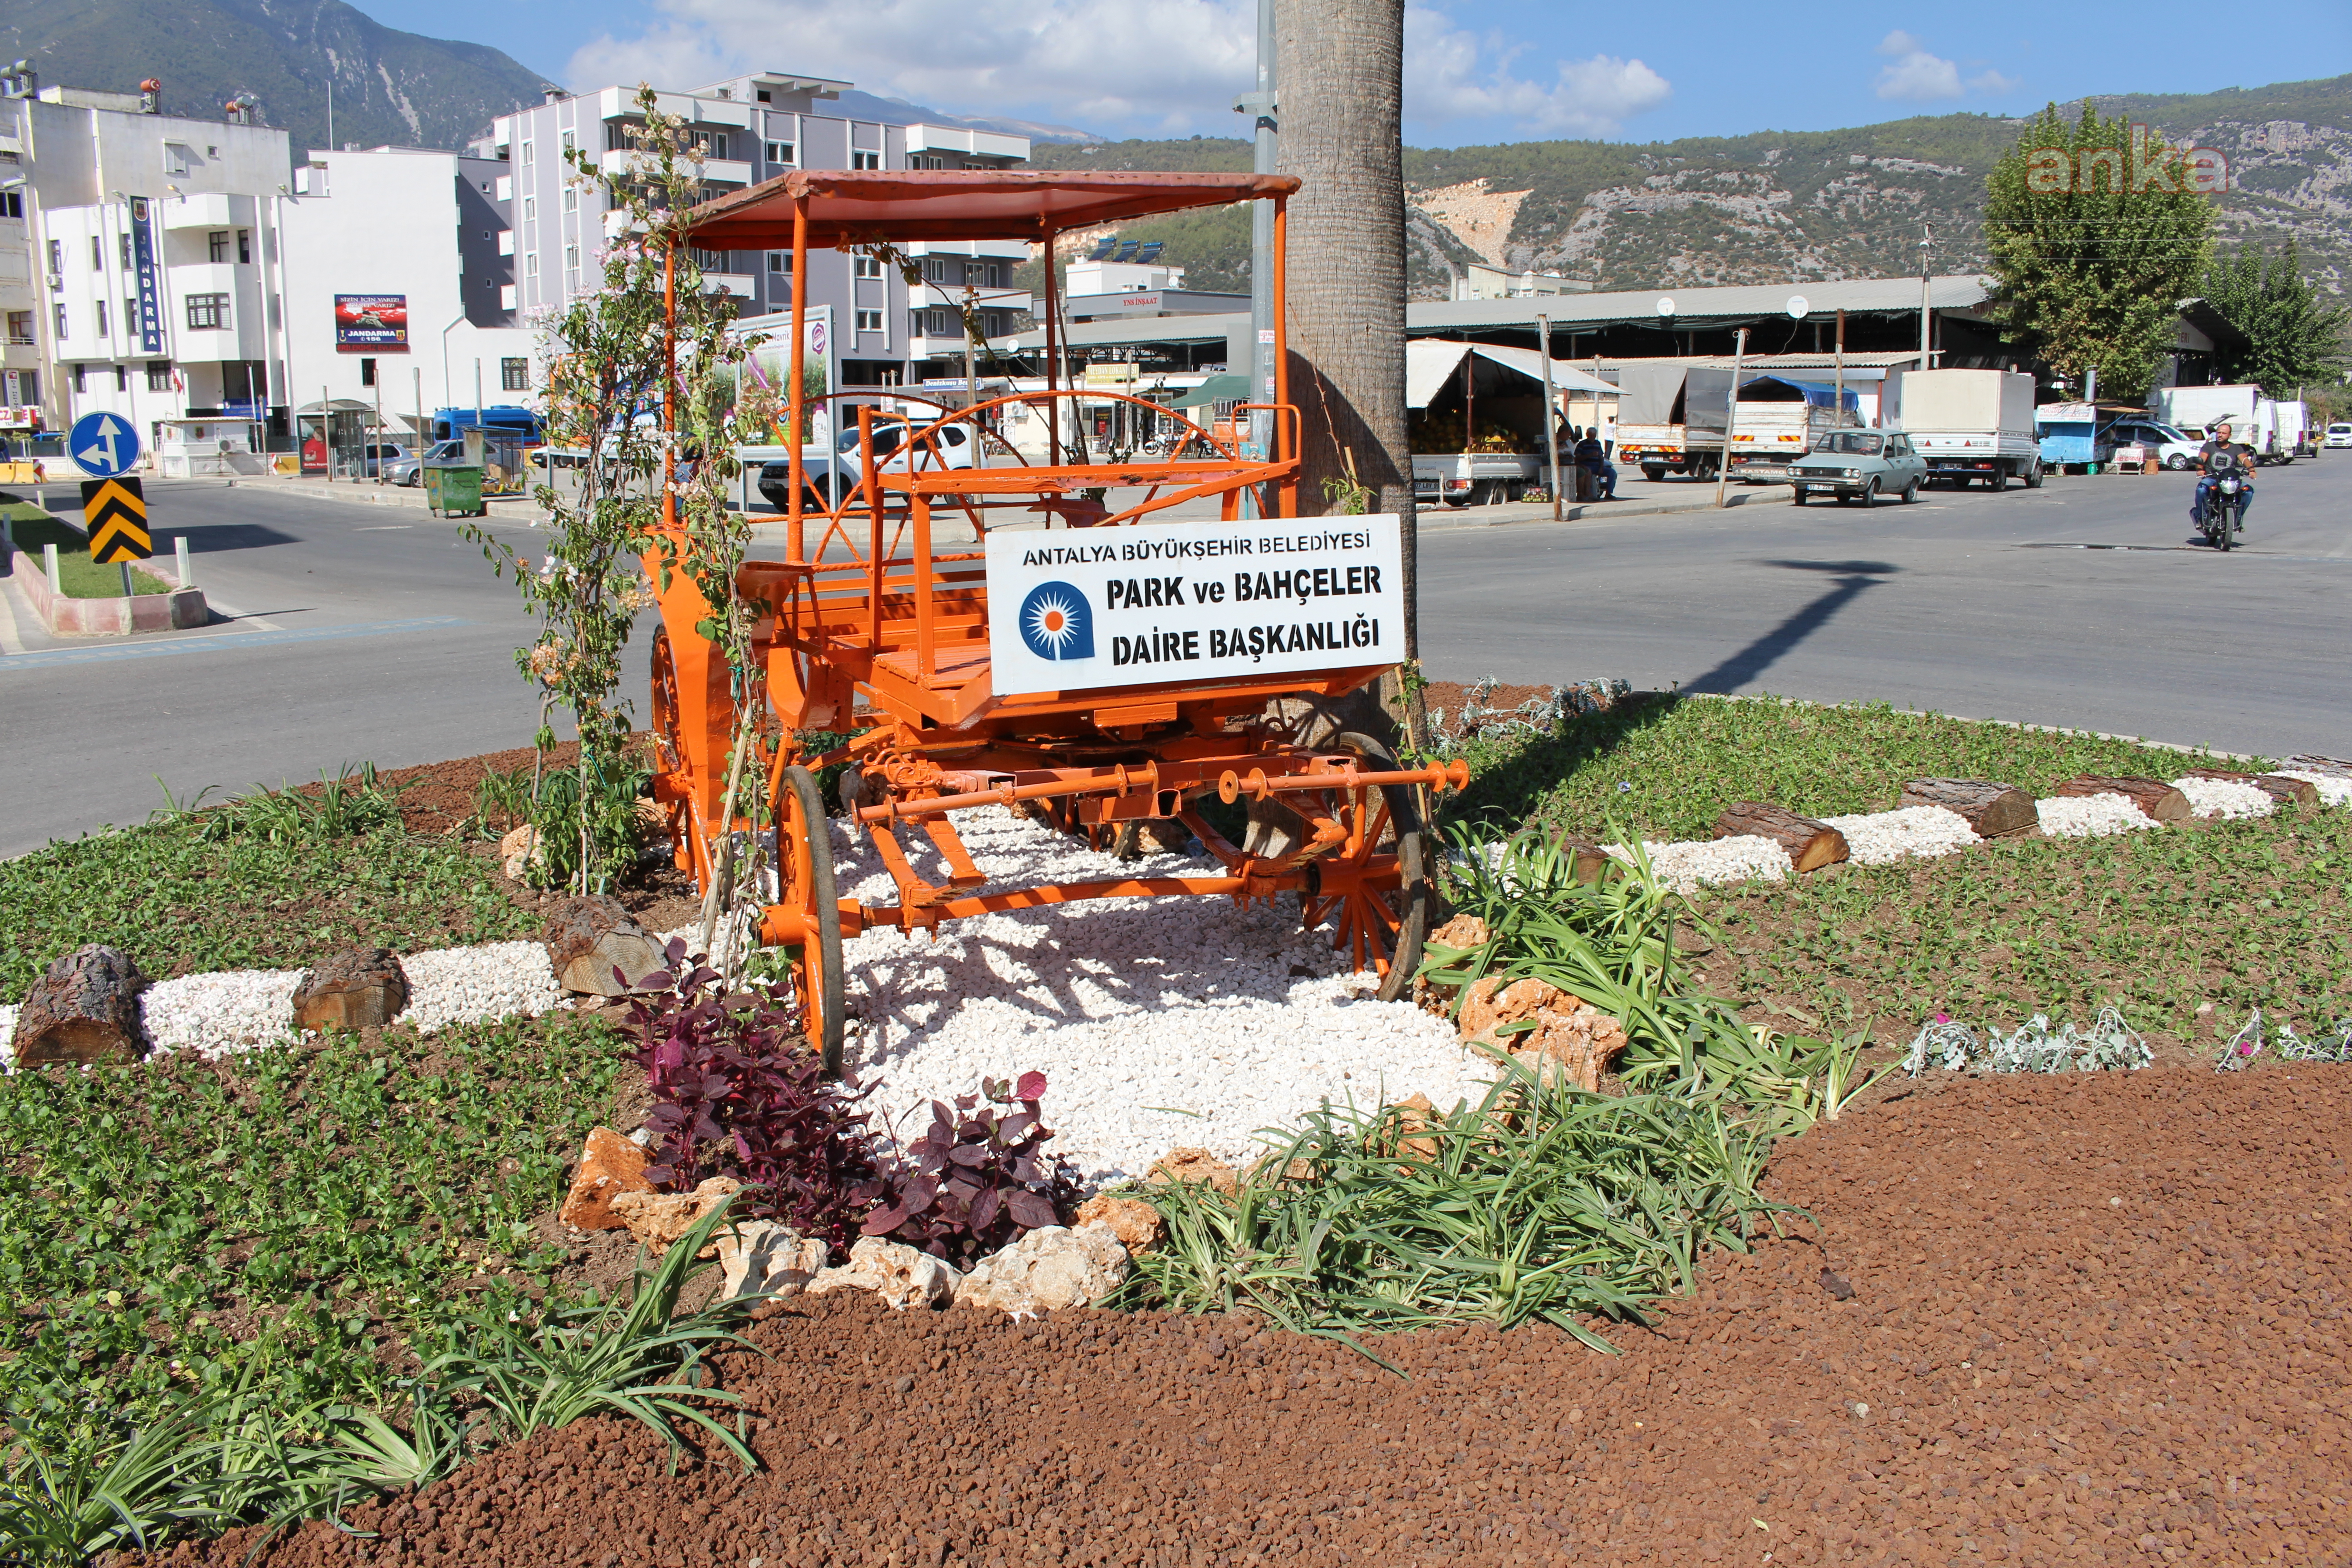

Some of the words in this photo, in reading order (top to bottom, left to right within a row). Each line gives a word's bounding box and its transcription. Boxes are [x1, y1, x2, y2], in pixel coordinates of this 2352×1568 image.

[140, 235, 157, 345] JANDARMA
[1135, 297, 1157, 307] İNŞAAT
[772, 330, 790, 342] Mavrik
[1089, 366, 1108, 375] MEYDAN
[1109, 365, 1137, 374] LOKANTSI
[1023, 545, 1116, 566] ANTALYA
[1122, 535, 1252, 561] BÜYÜKŞEHİR
[1259, 529, 1370, 554] BELEDİYESİ
[1107, 577, 1185, 609] PARK
[1194, 582, 1225, 603] ve
[1235, 566, 1381, 605] BAHÇELER
[1113, 627, 1199, 665] DAİRE
[1210, 613, 1379, 662] BAŞKANLIĞI
